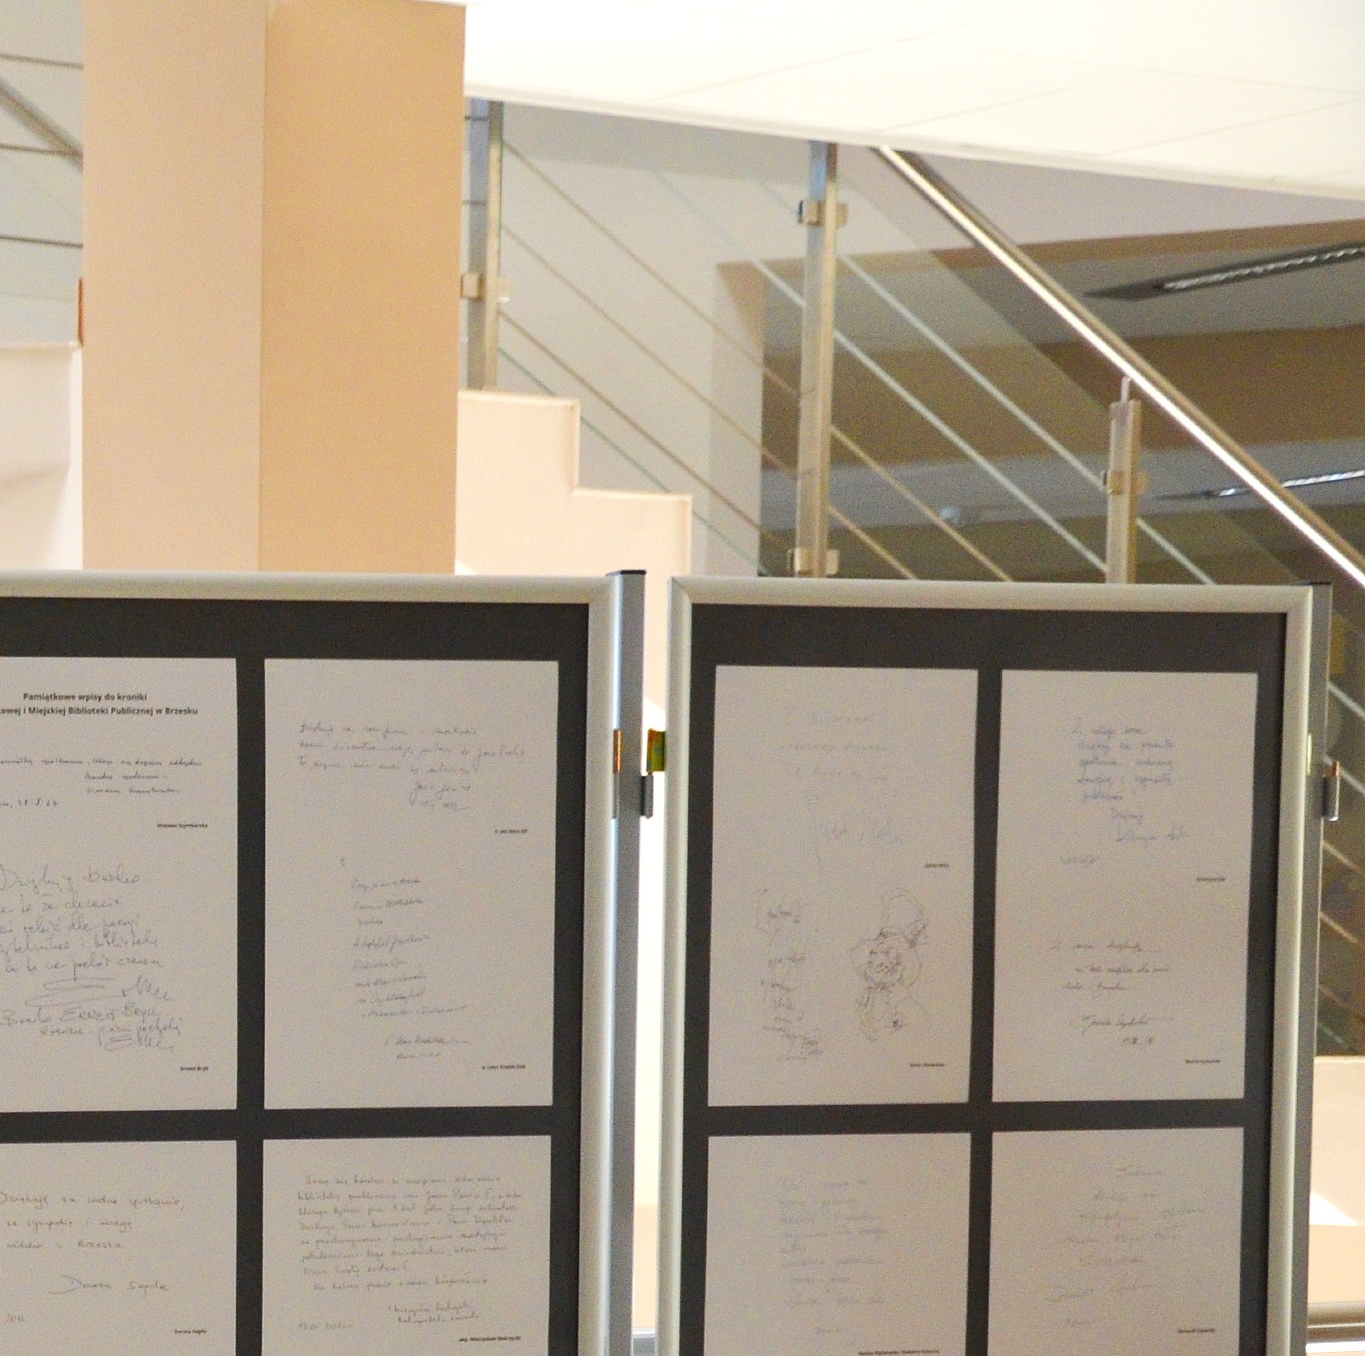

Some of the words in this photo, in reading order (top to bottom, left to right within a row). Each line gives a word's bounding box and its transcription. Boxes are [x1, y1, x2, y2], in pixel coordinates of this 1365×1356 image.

[23, 693, 76, 702] Pamiątkowe
[78, 693, 102, 702] wpisy
[28, 707, 66, 716] Miejskiej
[111, 707, 154, 716] Publicznej
